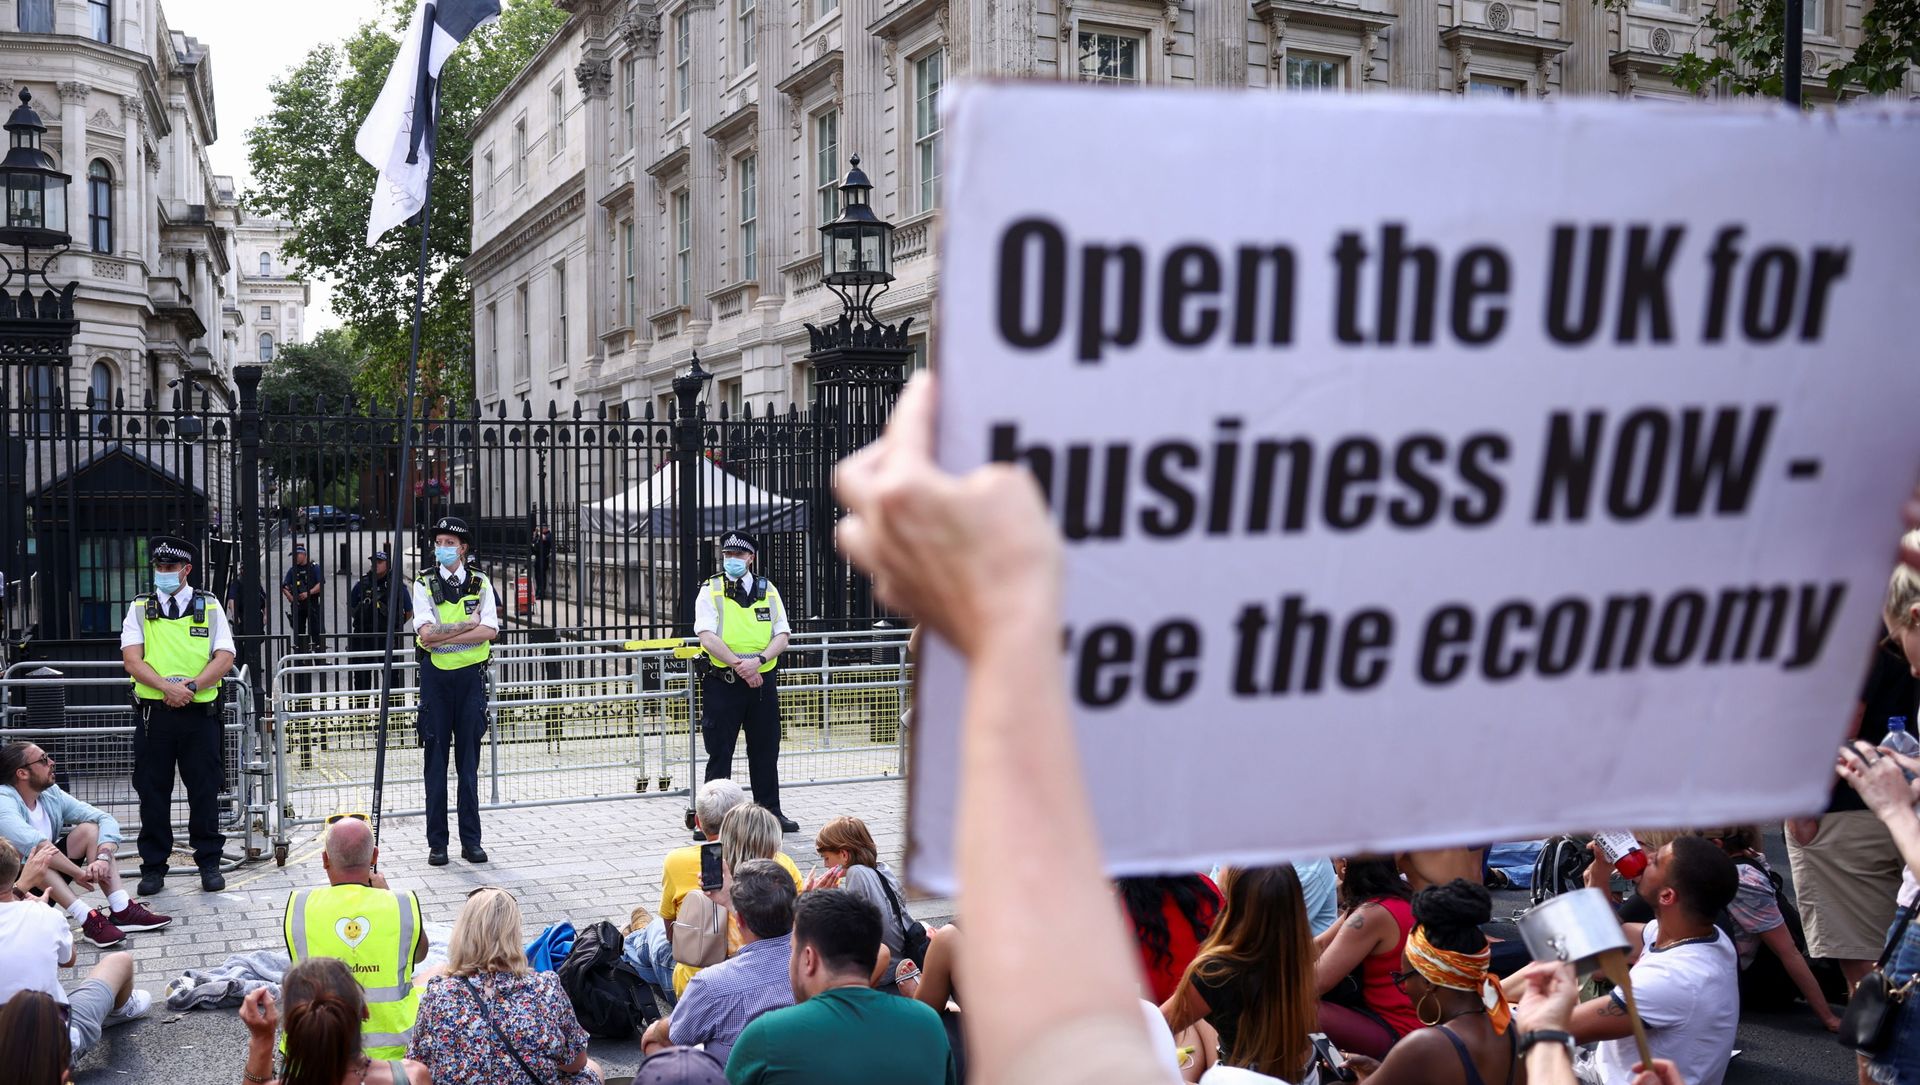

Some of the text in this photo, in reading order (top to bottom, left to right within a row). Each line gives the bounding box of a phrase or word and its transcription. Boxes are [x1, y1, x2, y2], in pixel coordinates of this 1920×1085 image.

[994, 215, 1855, 366] Open the UK for
[1529, 401, 1781, 527] NOW
[642, 661, 686, 670] ENTANCE
[1062, 576, 1853, 713] ee the economy
